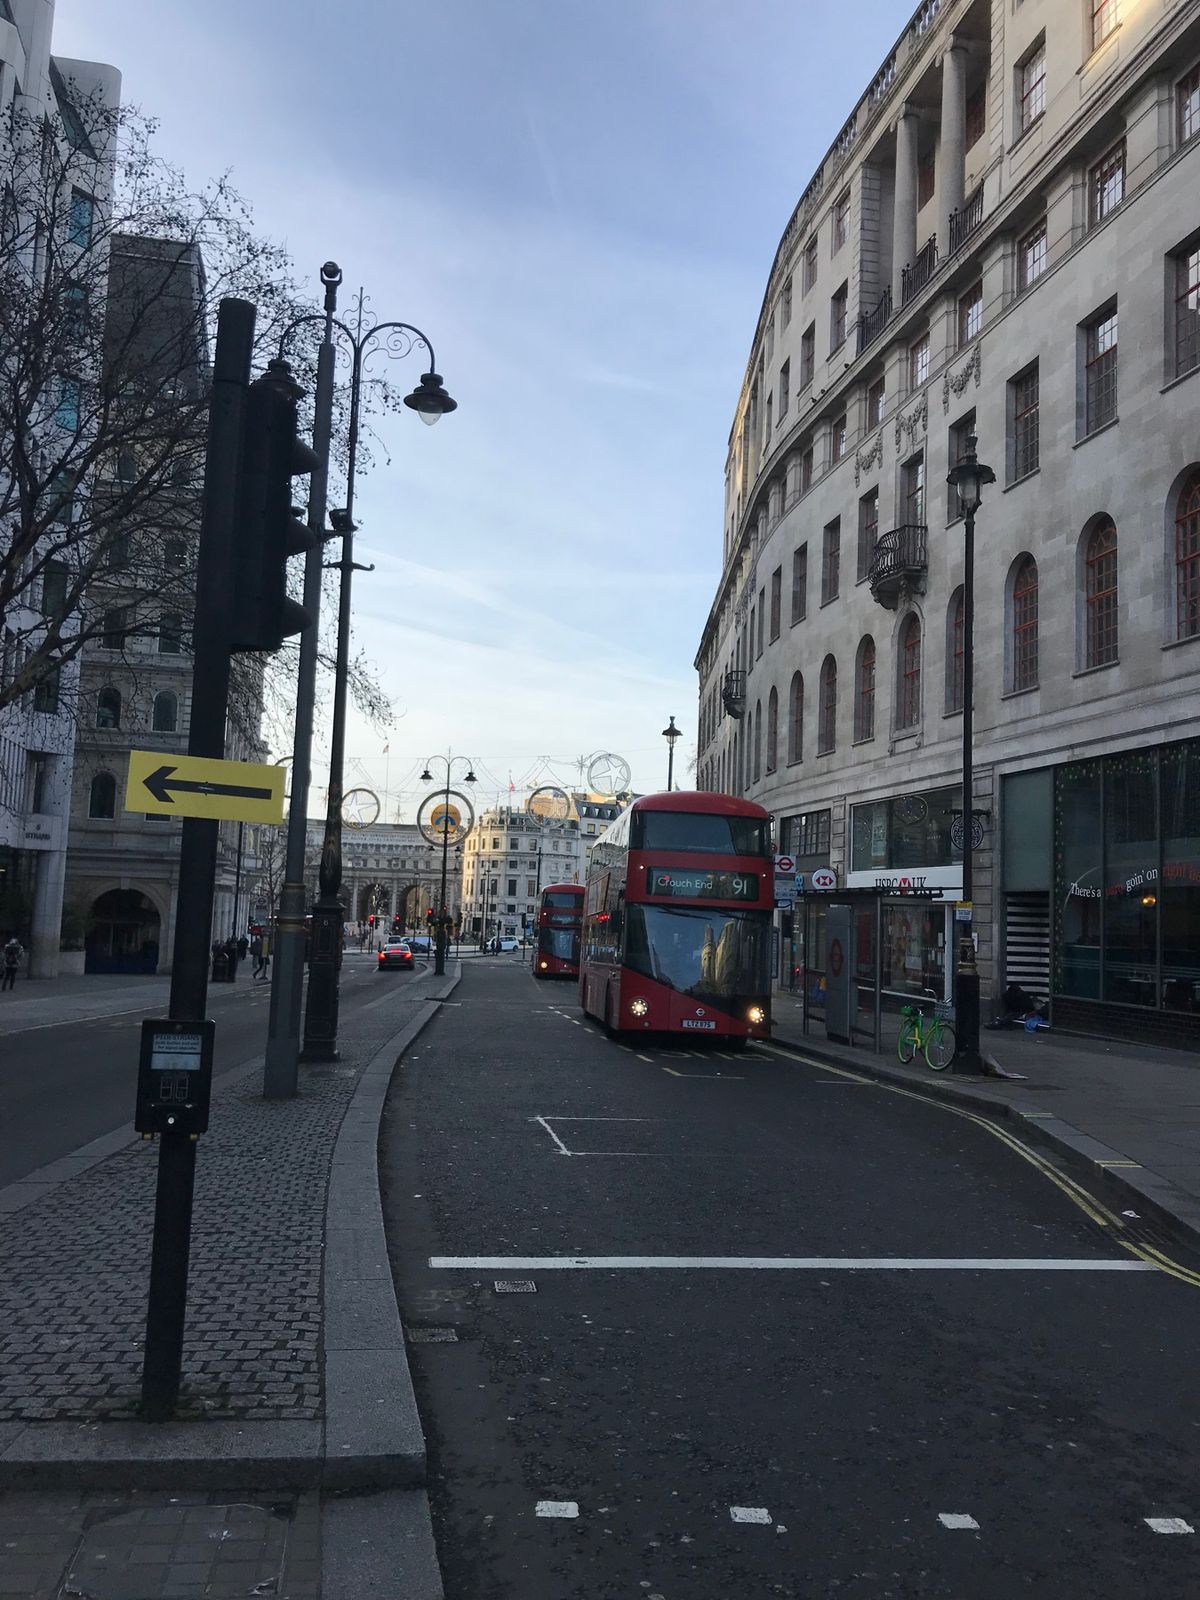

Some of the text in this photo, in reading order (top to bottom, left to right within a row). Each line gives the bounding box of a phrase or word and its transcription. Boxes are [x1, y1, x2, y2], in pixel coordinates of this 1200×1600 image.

[657, 876, 713, 889] Crouch End
[732, 878, 747, 895] 91
[1070, 882, 1096, 898] There's
[1096, 889, 1102, 898] a
[1146, 868, 1158, 881] on
